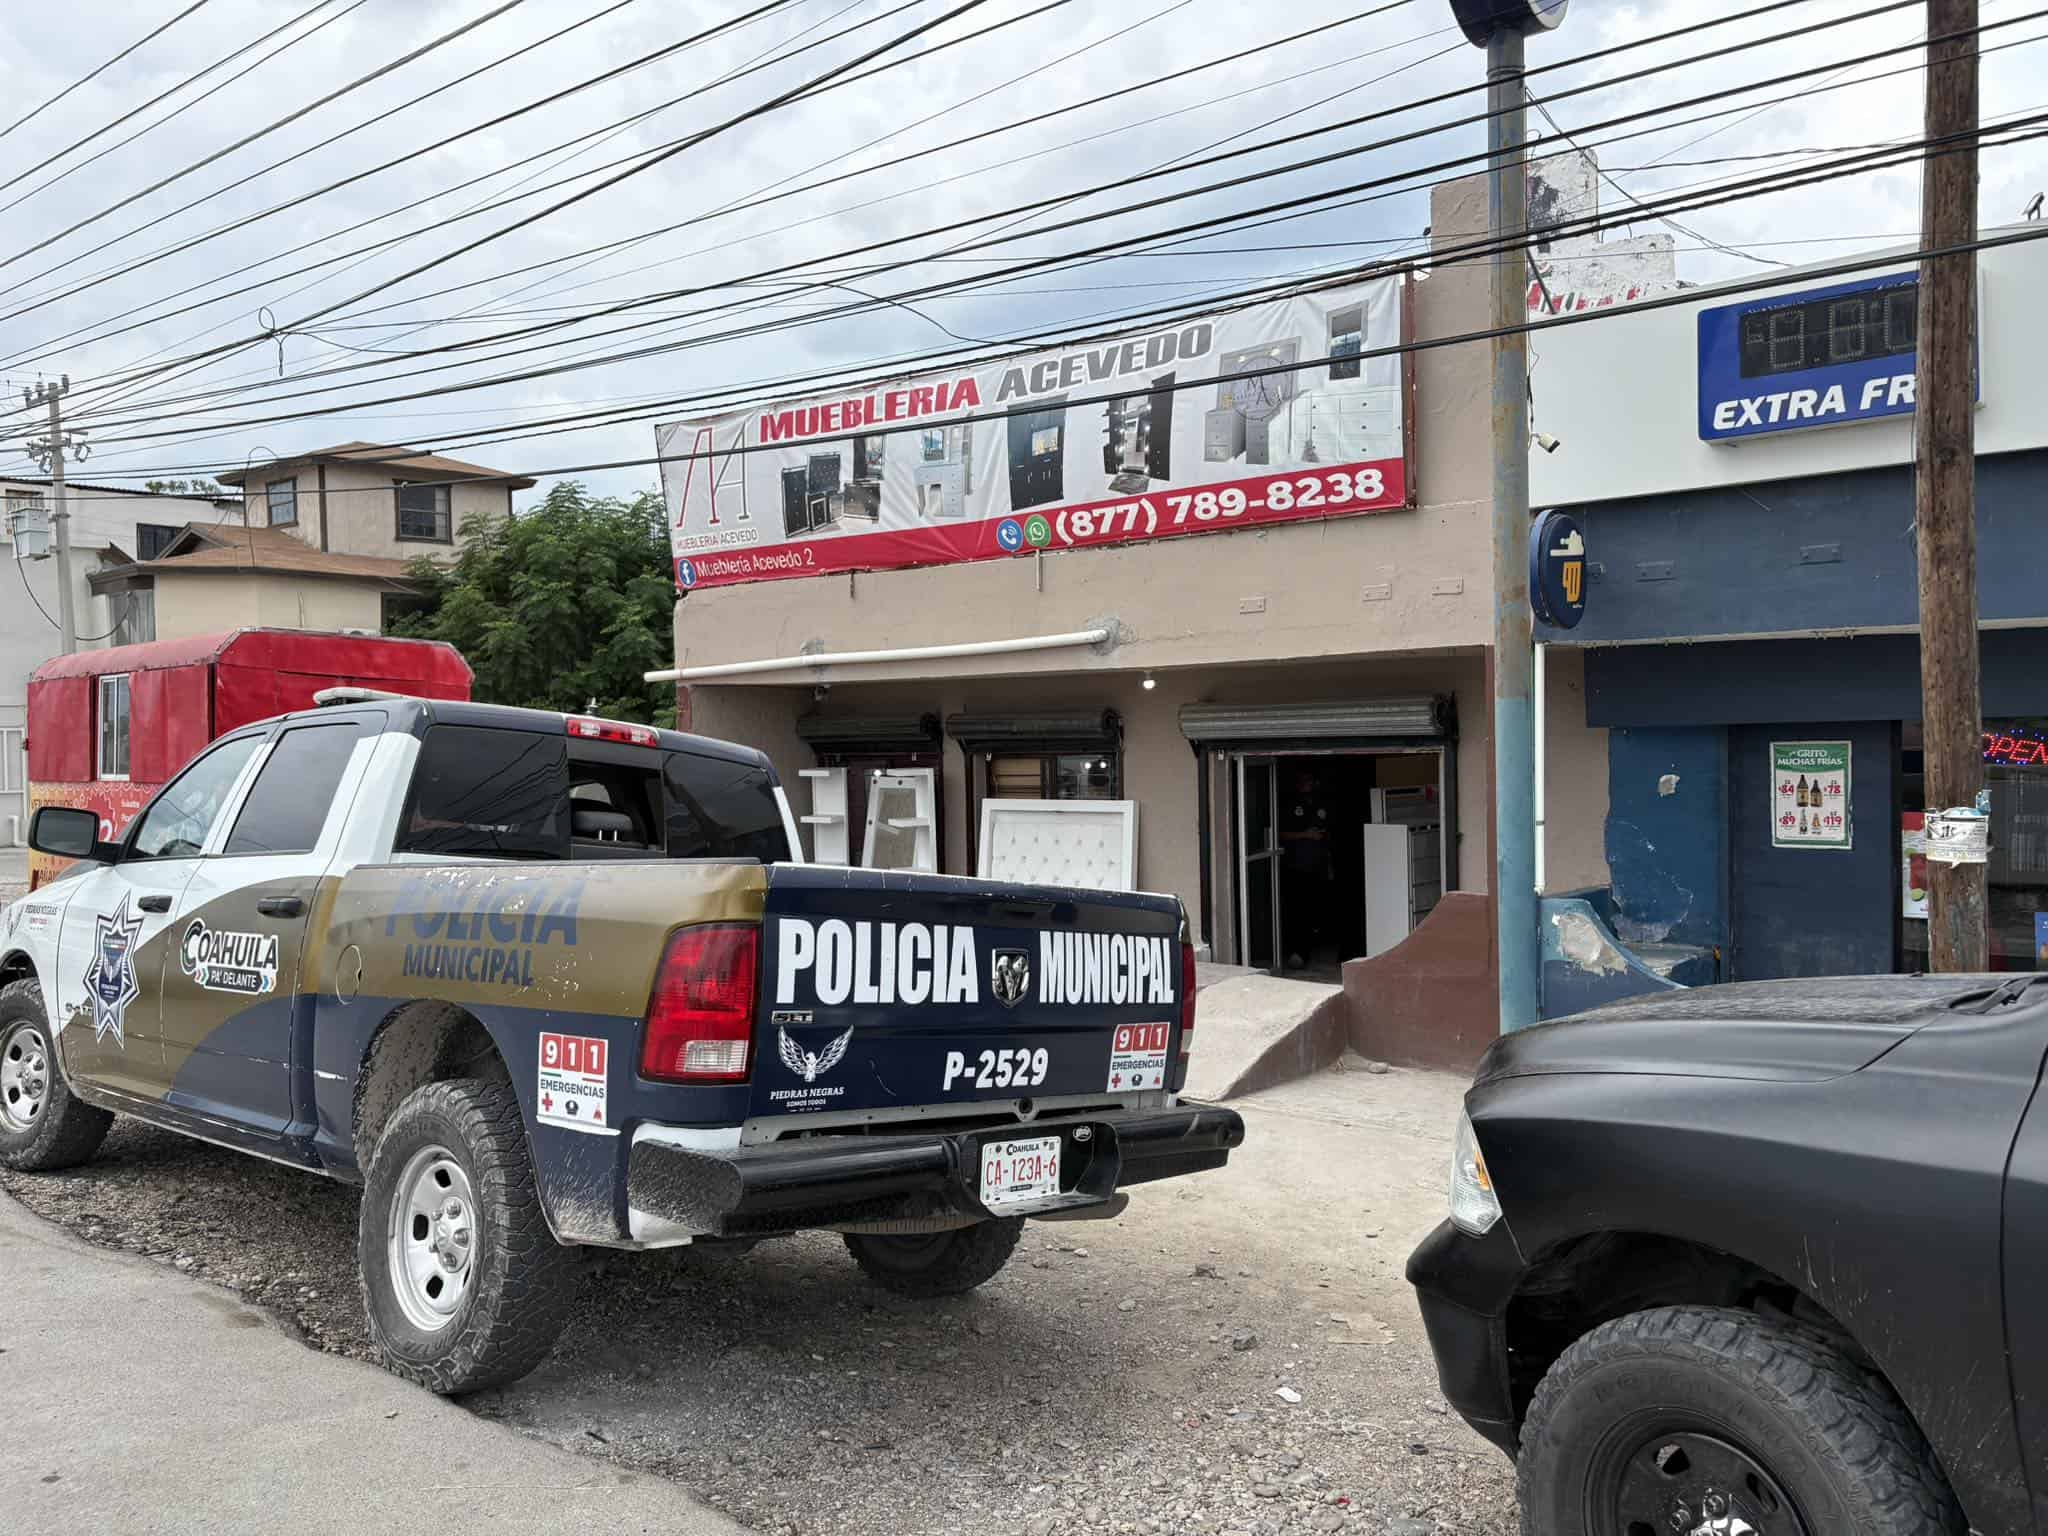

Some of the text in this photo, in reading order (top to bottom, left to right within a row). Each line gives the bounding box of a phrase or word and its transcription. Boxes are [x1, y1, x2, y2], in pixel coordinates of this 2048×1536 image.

[759, 323, 1213, 443] MUEBLERIA ACEVEDO
[1713, 373, 1917, 431] EXTRA FR
[1055, 468, 1385, 545] (877) 789-8238
[720, 529, 759, 545] ACEVEDO
[753, 550, 802, 571] Acevedo
[804, 547, 816, 566] 2
[1981, 733, 2048, 764] OPEN
[384, 877, 587, 946] POLICIA
[181, 919, 279, 975] COAHUILA
[775, 918, 1176, 1006] POLICIA MUNICIPAL
[223, 971, 258, 989] DELANTE
[402, 943, 535, 987] MUNICIPAL
[1119, 1026, 1163, 1049] 911
[545, 1039, 600, 1070] 911
[943, 1048, 1049, 1091] P-2529
[1111, 1058, 1165, 1071] EMERGENCIAS
[540, 1079, 605, 1099] EMERGENCIAS
[770, 1086, 845, 1100] PIEDRAS NEGRAS
[985, 1154, 1058, 1187] CA-123A-6
